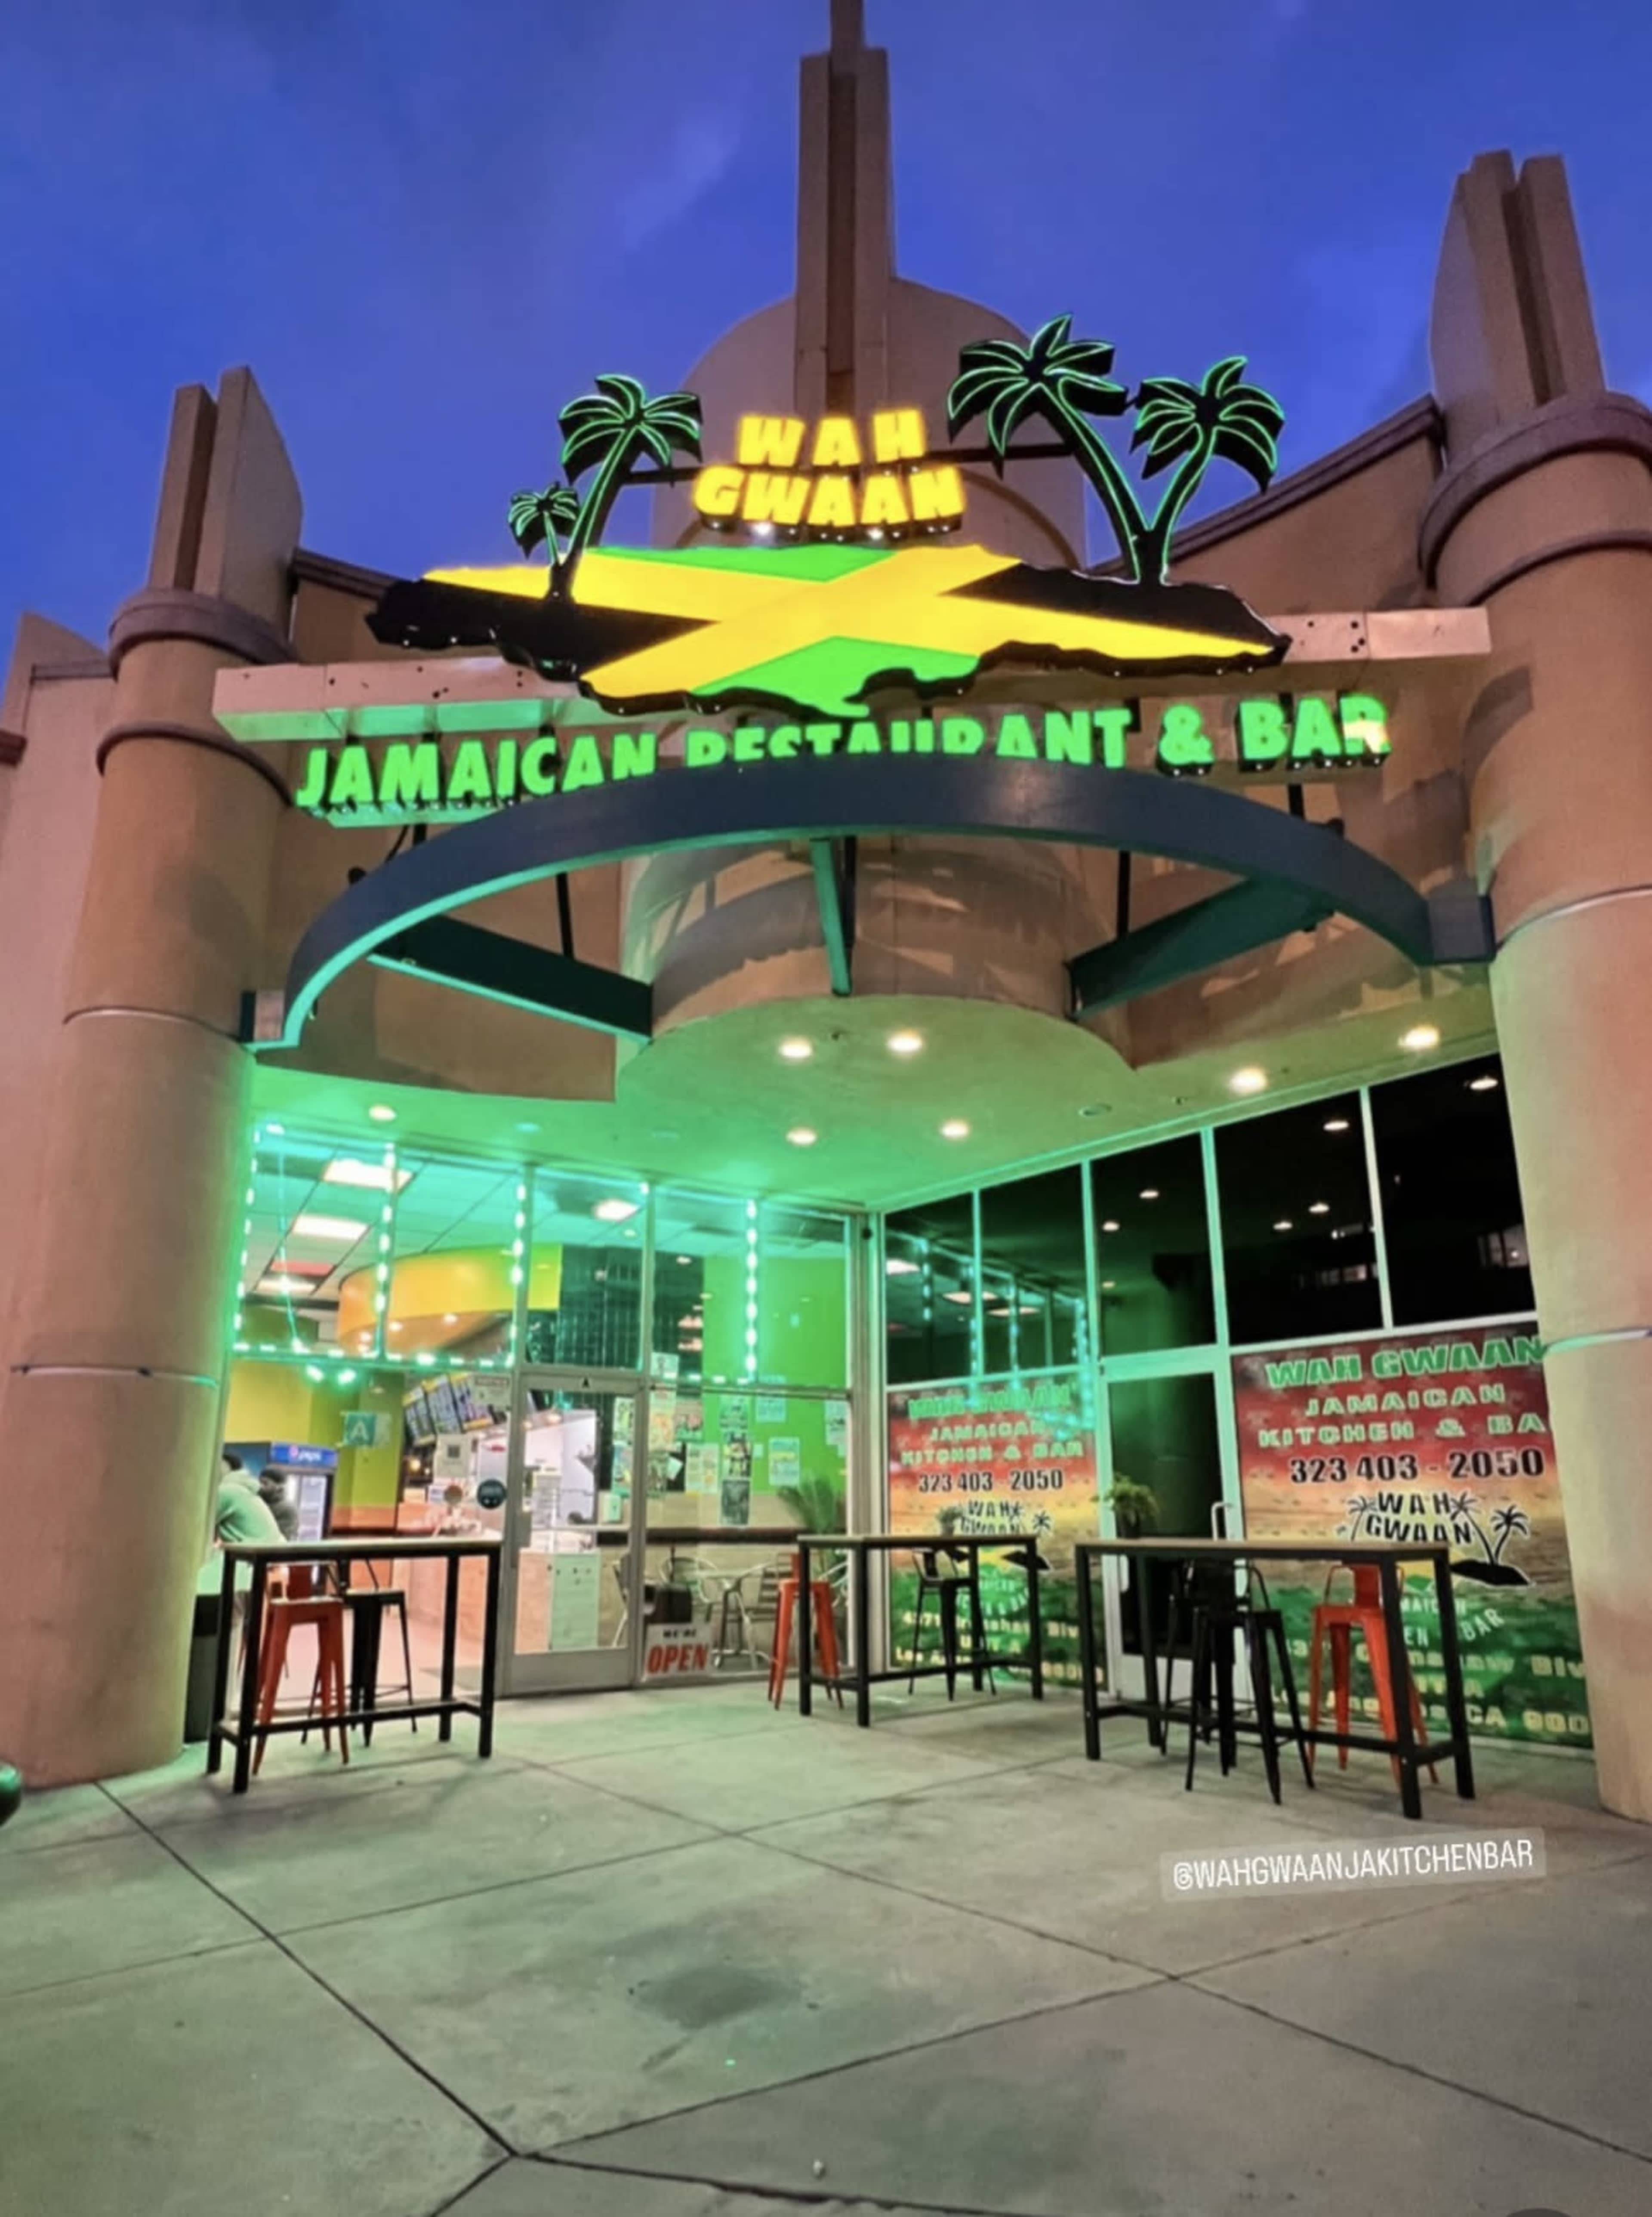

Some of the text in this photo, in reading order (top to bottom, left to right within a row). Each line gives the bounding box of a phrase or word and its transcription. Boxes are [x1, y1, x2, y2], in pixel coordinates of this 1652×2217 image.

[738, 409, 926, 467] WAH
[693, 465, 965, 527] GWAAN
[296, 733, 656, 807] JAMAICAN
[1159, 704, 1214, 766] &
[1239, 693, 1393, 762] BAR
[1266, 1335, 1546, 1389] WAH GWAAN
[1305, 1383, 1505, 1417] JAMAICAN
[1258, 1414, 1548, 1447] KITCHEN & BA
[919, 1469, 1063, 1492] 323 403 2050
[1291, 1457, 1347, 1483] 323
[1356, 1454, 1418, 1481] 403
[1449, 1448, 1544, 1478] 2050
[1378, 1492, 1451, 1515] WAH
[1365, 1514, 1470, 1544] GWAAN
[647, 1644, 709, 1674] OPEN
[1465, 1704, 1507, 1728] CA
